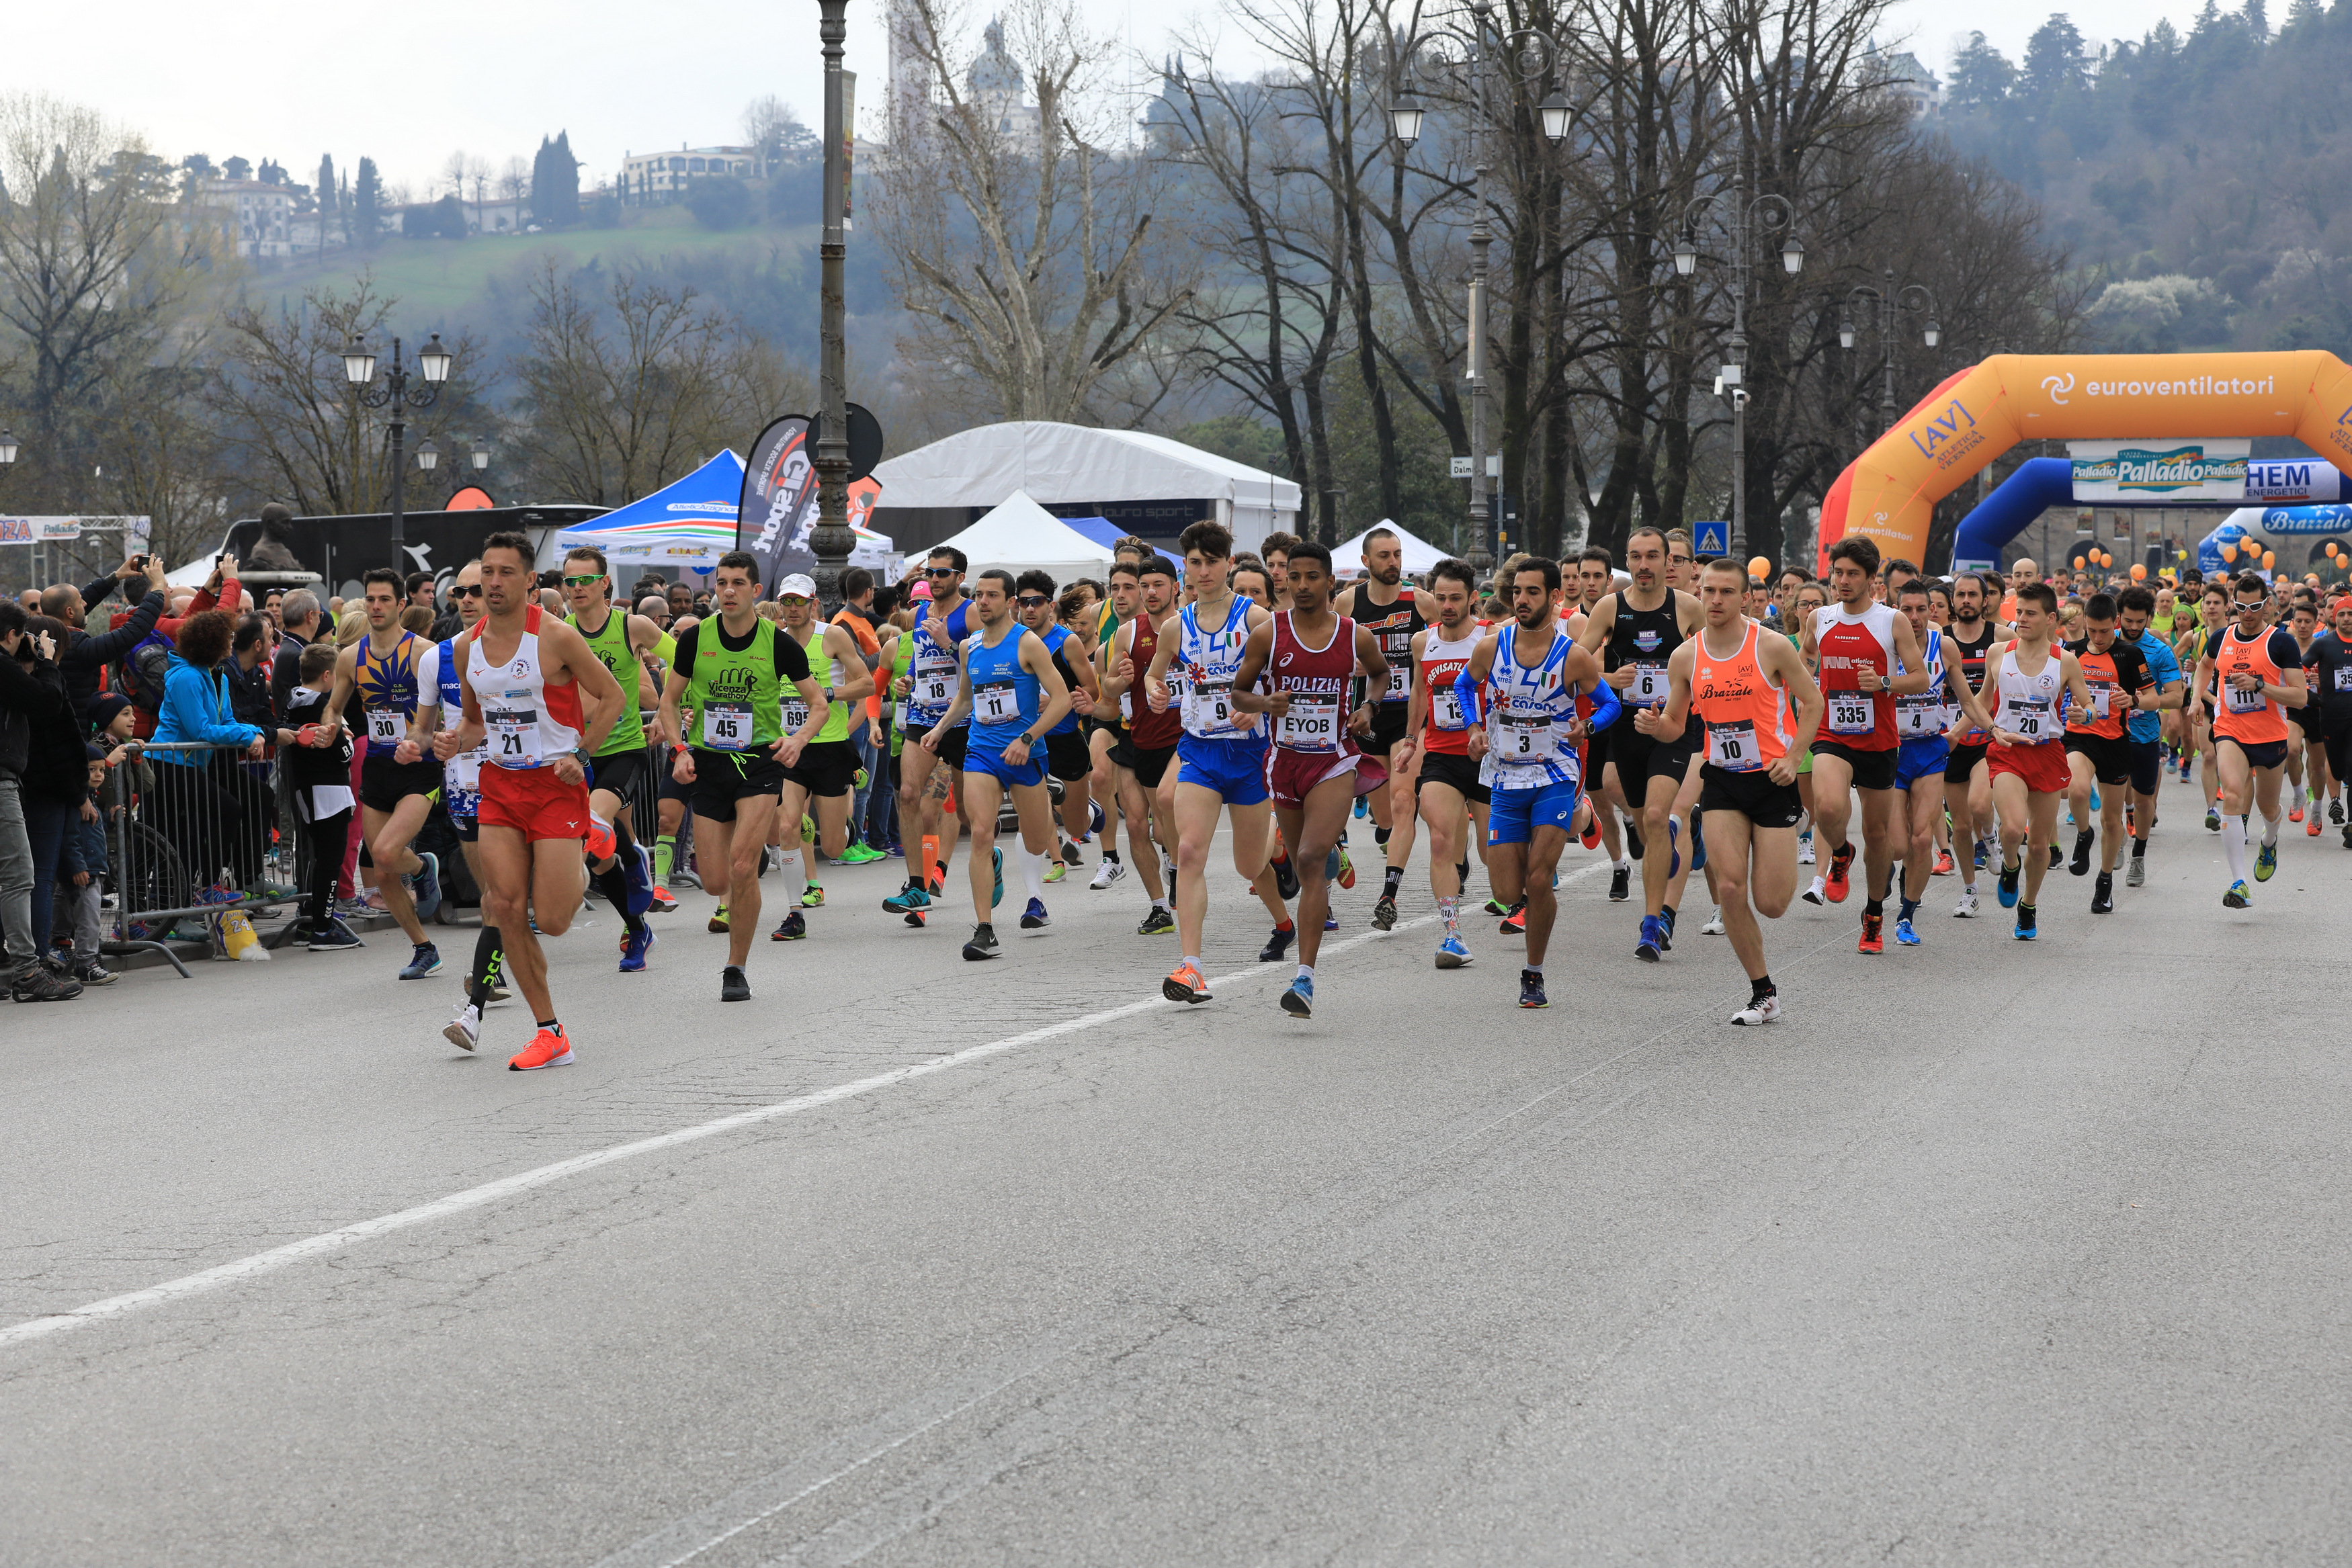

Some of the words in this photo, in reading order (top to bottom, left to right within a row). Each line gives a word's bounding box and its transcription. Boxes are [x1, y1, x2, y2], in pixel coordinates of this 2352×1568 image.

[2086, 376, 2274, 396] euroventilatori
[1937, 430, 1978, 464] ATLETICA
[1939, 435, 1986, 470] VICENTINA
[2073, 465, 2117, 478] Palladio
[2117, 460, 2203, 483] Palladio
[2247, 487, 2307, 496] ENERGETICI
[1105, 507, 1142, 517] puro
[1146, 505, 1194, 519] sport
[2265, 511, 2351, 530] Brazzale
[0, 519, 32, 541] ZA
[44, 523, 79, 535] Palladio
[1848, 526, 1913, 541] euroventilatori
[1385, 614, 1394, 627] 4
[1394, 612, 1411, 621] WIN
[708, 682, 746, 693] Vicenza
[929, 683, 946, 698] 18
[1282, 675, 1341, 692] POLIZIA
[1642, 677, 1653, 695] 6
[1700, 683, 1753, 699] Brazzale
[709, 689, 747, 699] Marathon
[988, 698, 1003, 715] 11
[1215, 702, 1228, 720] 9
[1512, 699, 1558, 712] casone
[1837, 706, 1867, 724] 335
[1912, 713, 1921, 729] 4
[376, 720, 395, 736] 30
[716, 720, 738, 738] 45
[1285, 717, 1330, 734] EYOB
[2019, 717, 2038, 734] 20
[501, 734, 523, 754] 21
[1519, 735, 1530, 753] 3
[1720, 740, 1742, 760] 10
[230, 918, 251, 934] 24
